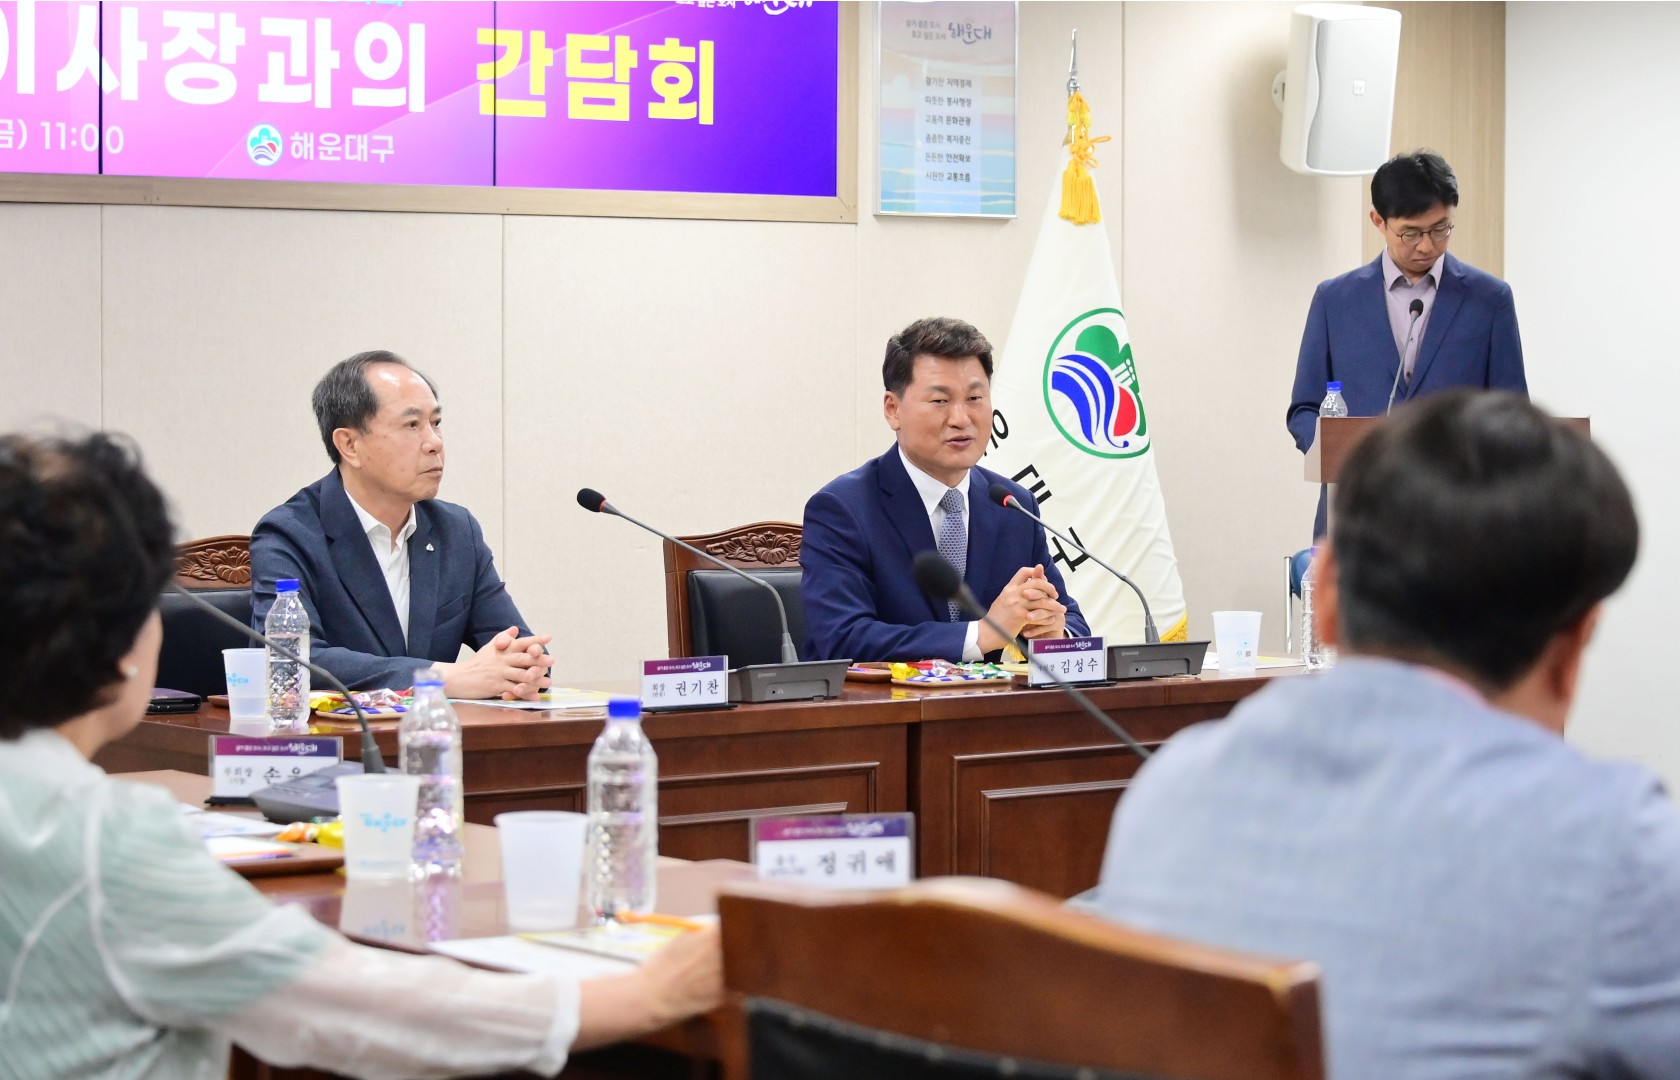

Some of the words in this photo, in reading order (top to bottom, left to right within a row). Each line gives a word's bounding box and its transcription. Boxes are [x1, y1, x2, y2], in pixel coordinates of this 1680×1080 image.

[948, 22, 992, 44] 해운대
[476, 27, 714, 126] 간담회
[40, 121, 125, 155] 11:00
[289, 132, 395, 164] 해운대구
[1060, 657, 1099, 674] 김성수
[675, 678, 720, 697] 권기찬
